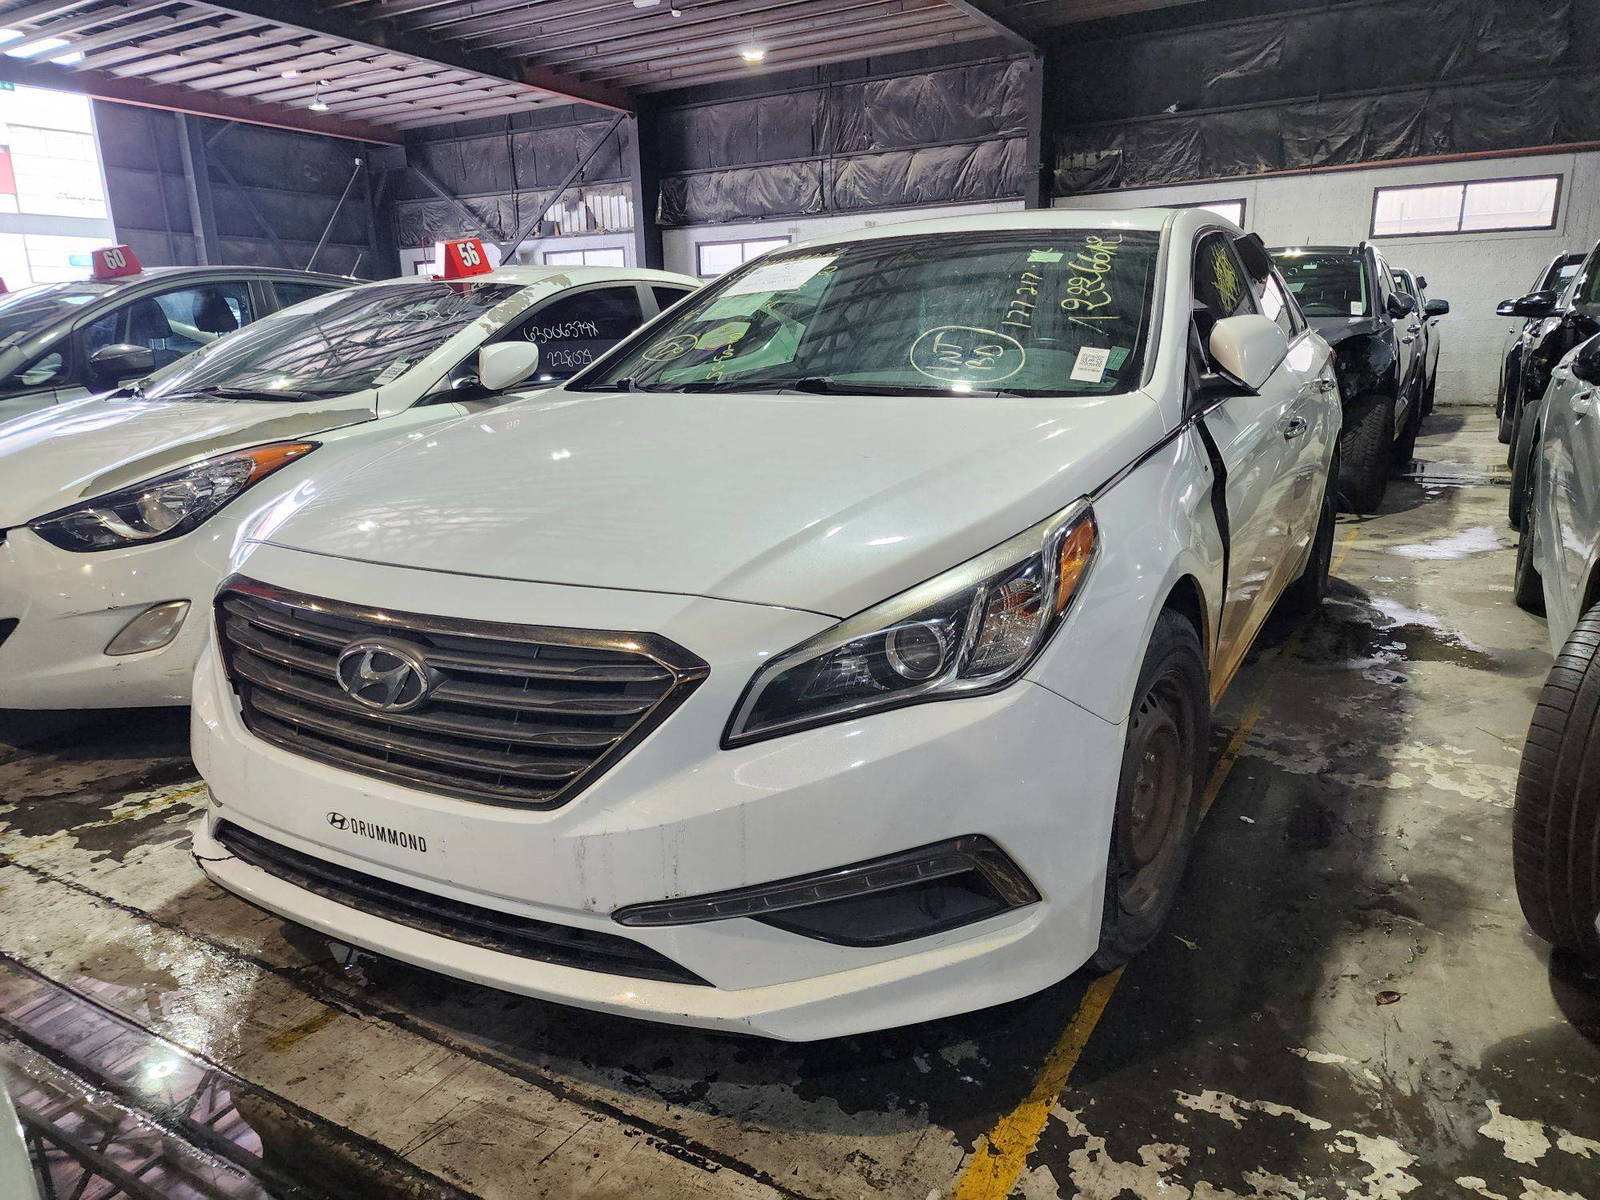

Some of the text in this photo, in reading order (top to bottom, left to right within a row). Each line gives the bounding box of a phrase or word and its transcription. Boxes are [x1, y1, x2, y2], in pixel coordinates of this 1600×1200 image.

[102, 247, 127, 270] 60
[457, 242, 481, 267] 56
[350, 818, 427, 853] DRUMMOND
